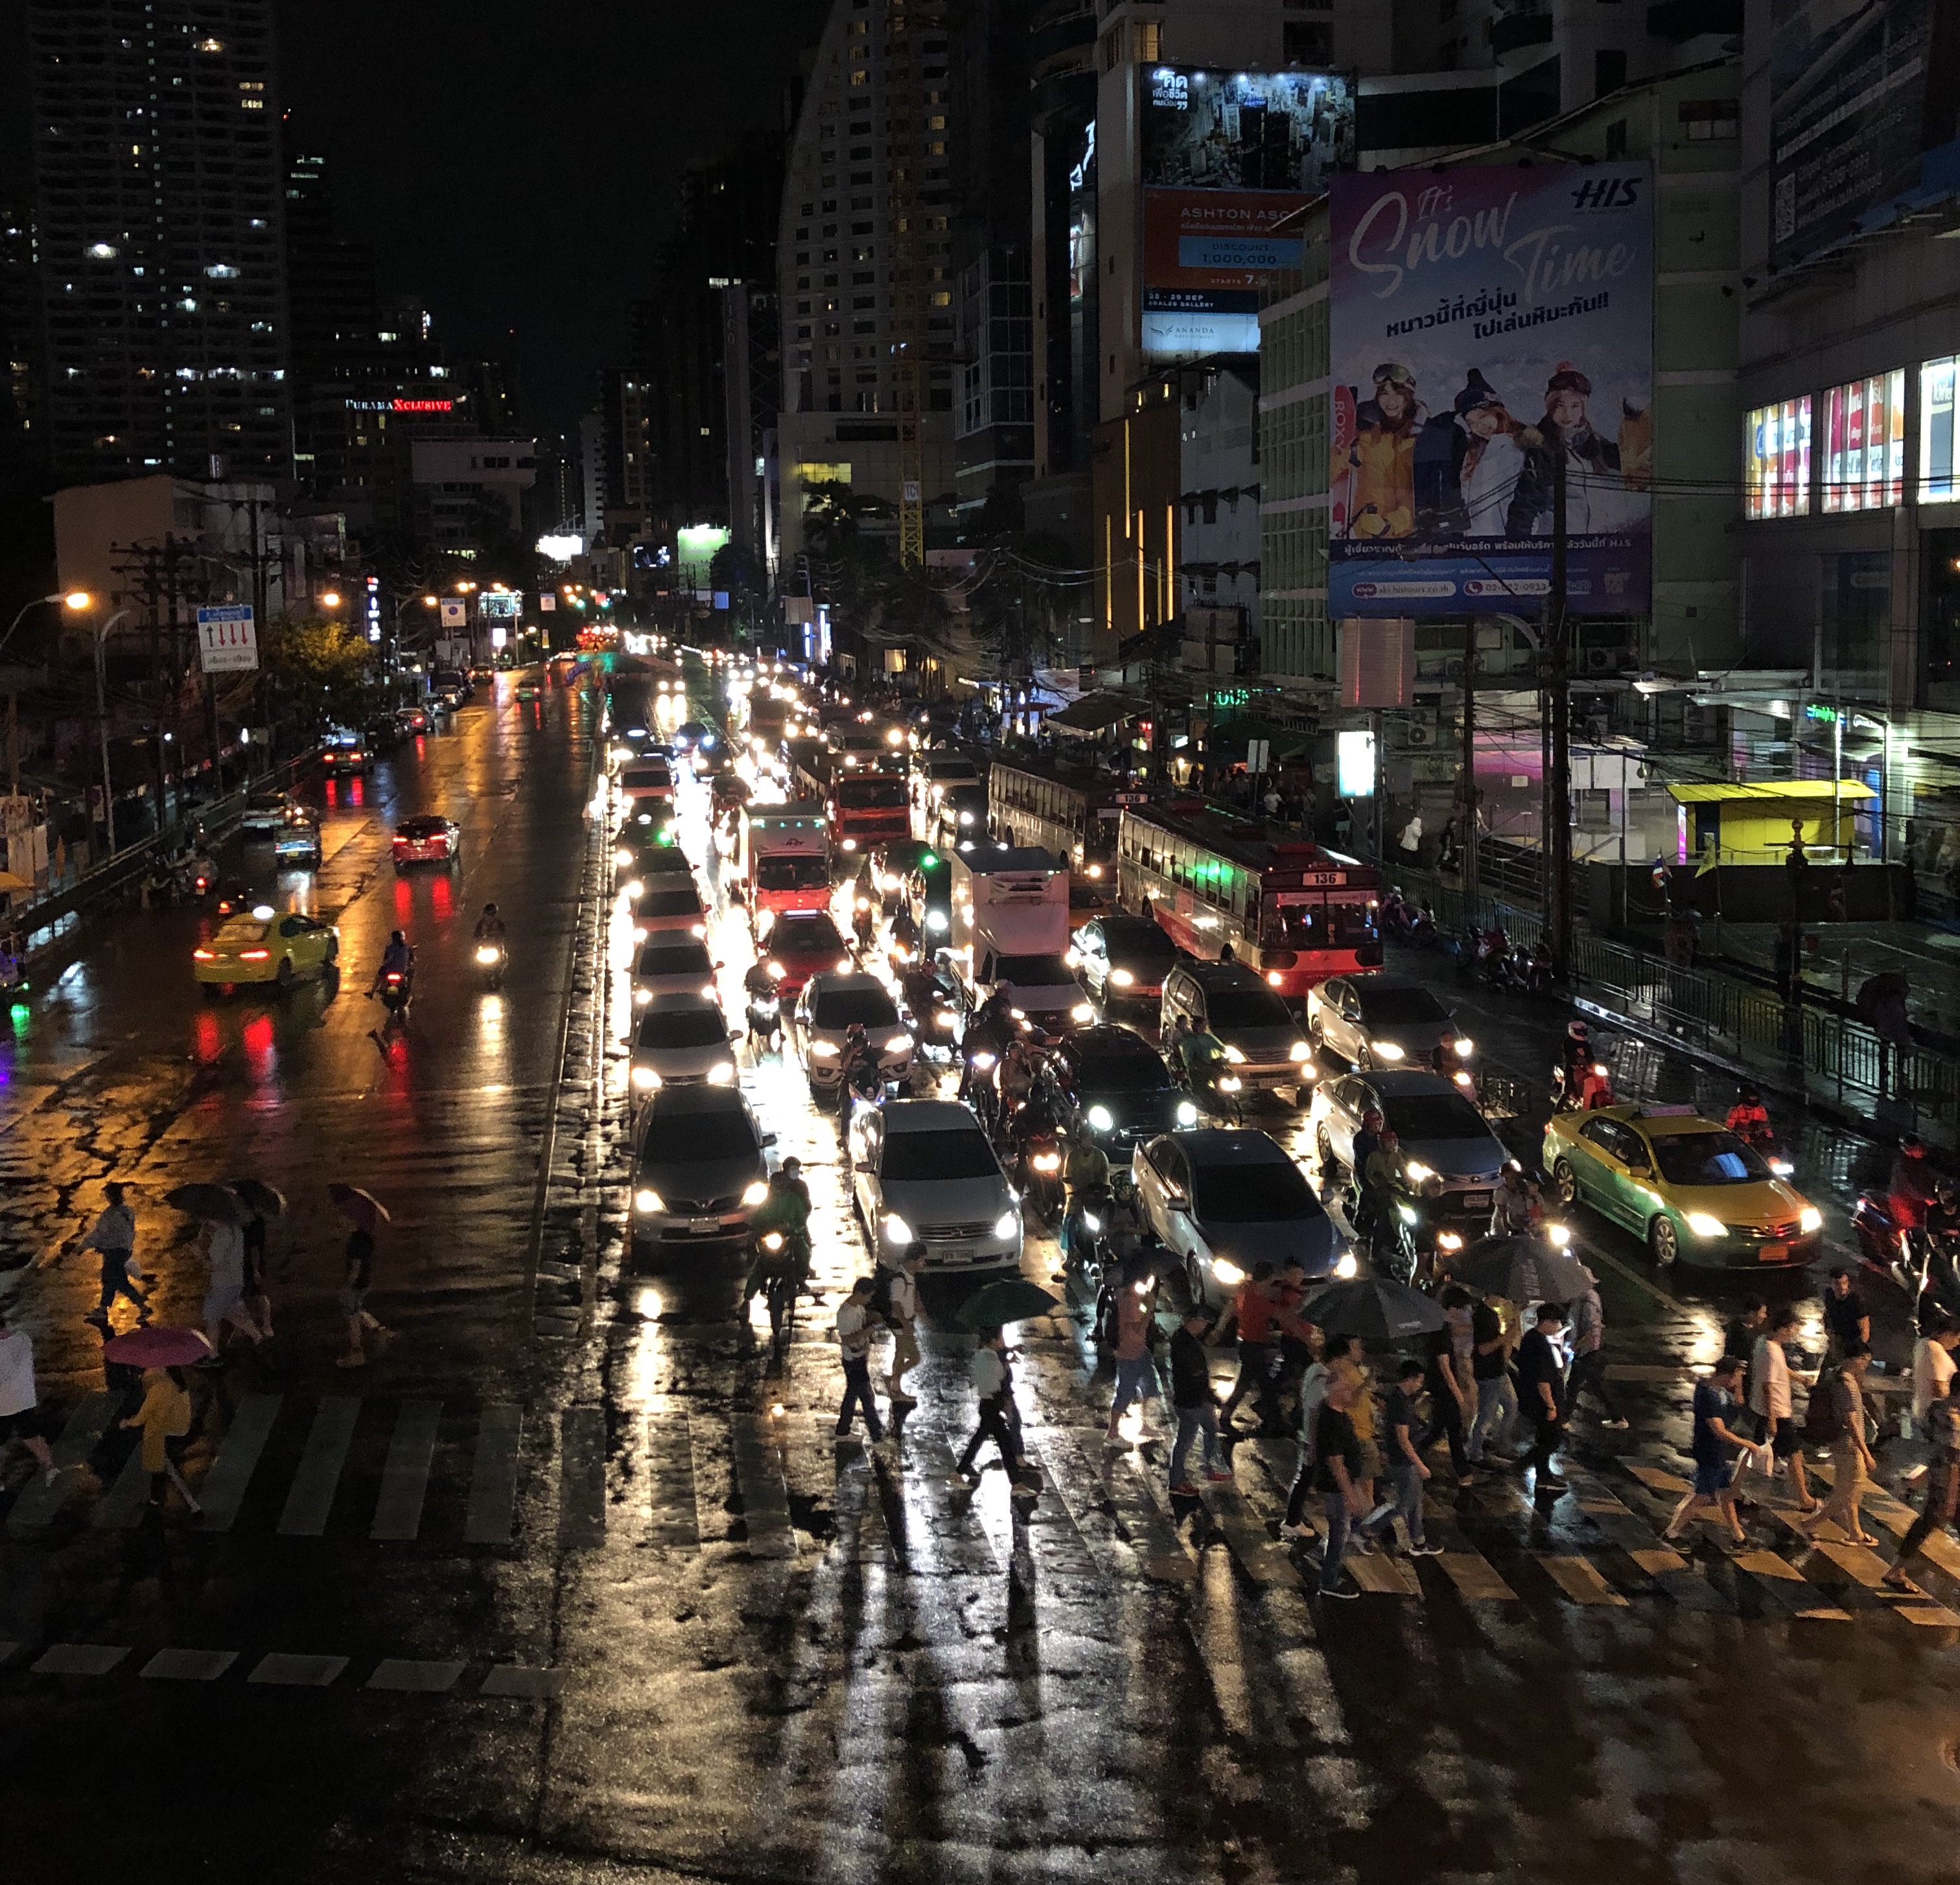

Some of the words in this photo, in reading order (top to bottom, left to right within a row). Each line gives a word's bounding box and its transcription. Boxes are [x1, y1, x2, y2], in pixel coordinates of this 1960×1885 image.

[1571, 178, 1642, 208] HIS
[1180, 207, 1251, 219] ASHTON
[1203, 253, 1277, 265] 1,000,000
[1349, 191, 1519, 298] Snow
[1504, 224, 1639, 305] Time
[1473, 291, 1609, 339] ไปเล่นหิมะกัน!!
[1335, 401, 1346, 450] ROXY
[1314, 873, 1337, 885] 136
